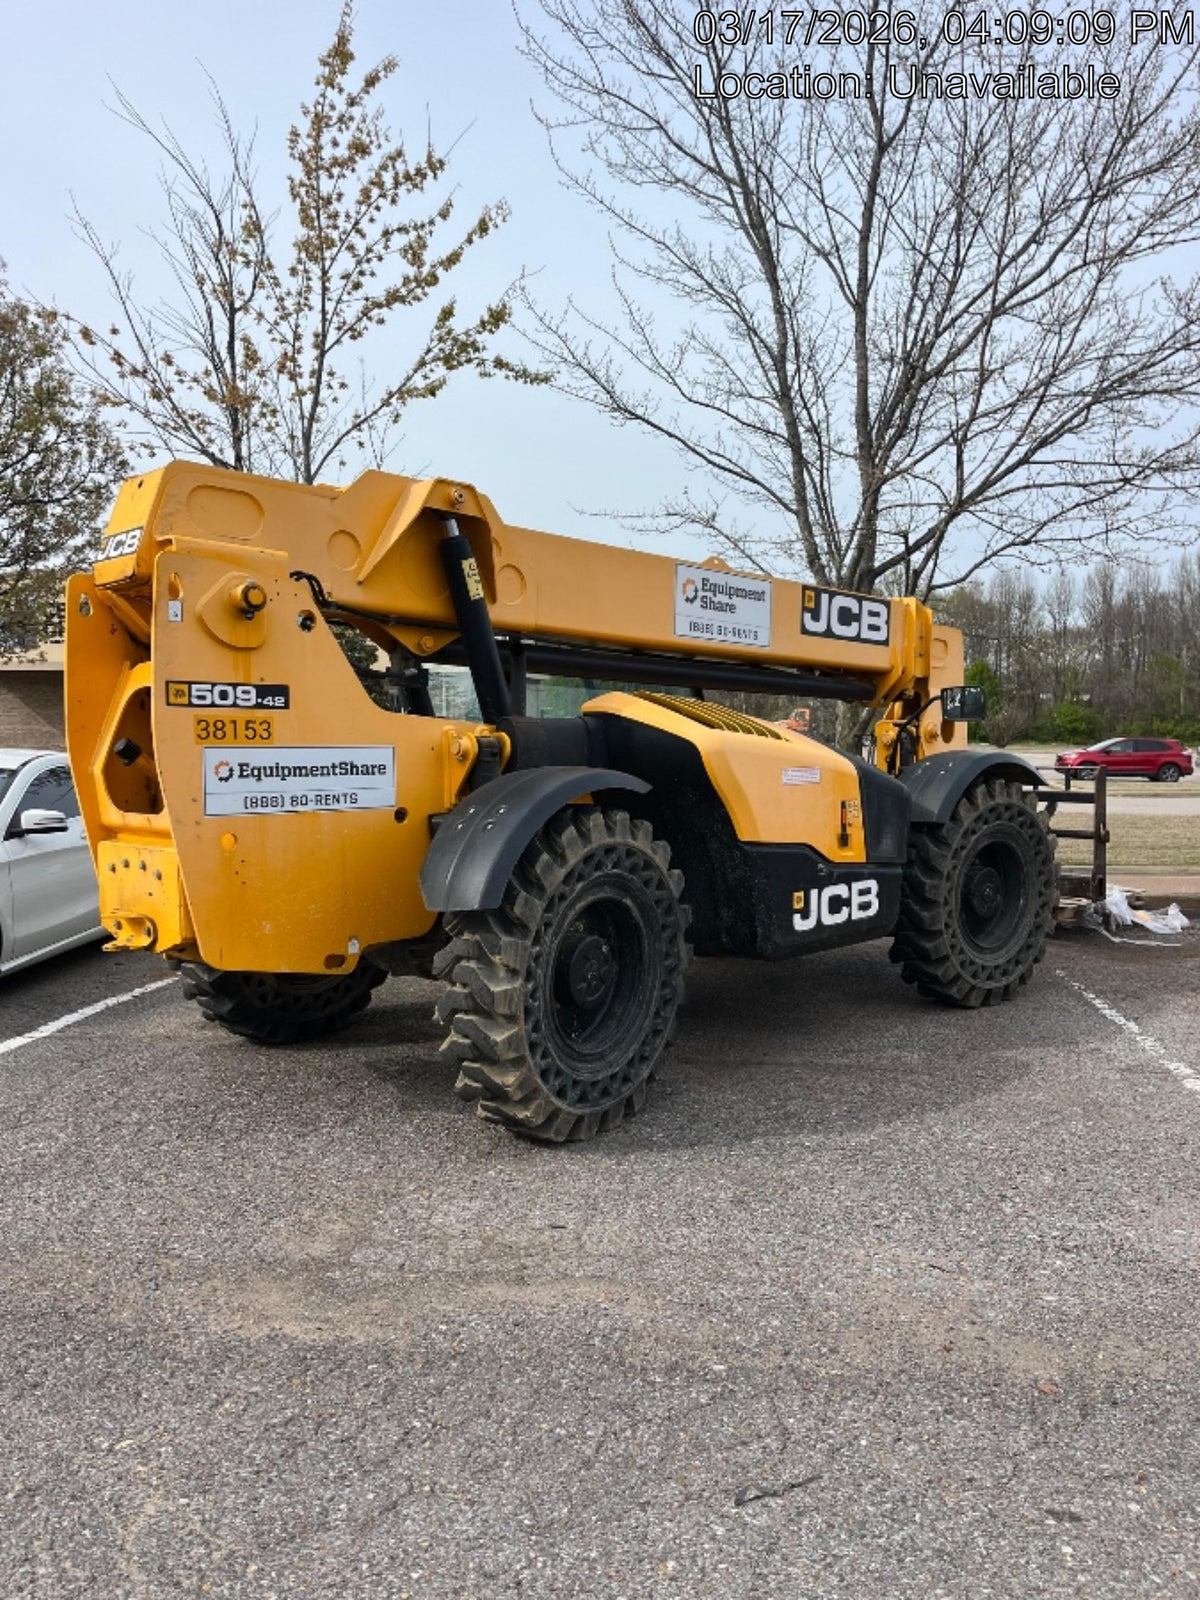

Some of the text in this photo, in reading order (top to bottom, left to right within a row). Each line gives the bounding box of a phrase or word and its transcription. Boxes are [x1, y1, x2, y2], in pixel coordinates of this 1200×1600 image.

[97, 529, 141, 560] JCB
[701, 577, 766, 602] Equipment
[700, 595, 736, 614] Share
[803, 592, 888, 641] JCB
[196, 719, 273, 740] 38153
[237, 761, 387, 782] EquipmentShare
[290, 792, 358, 808] 80-RENTS
[792, 879, 879, 931] JCB
